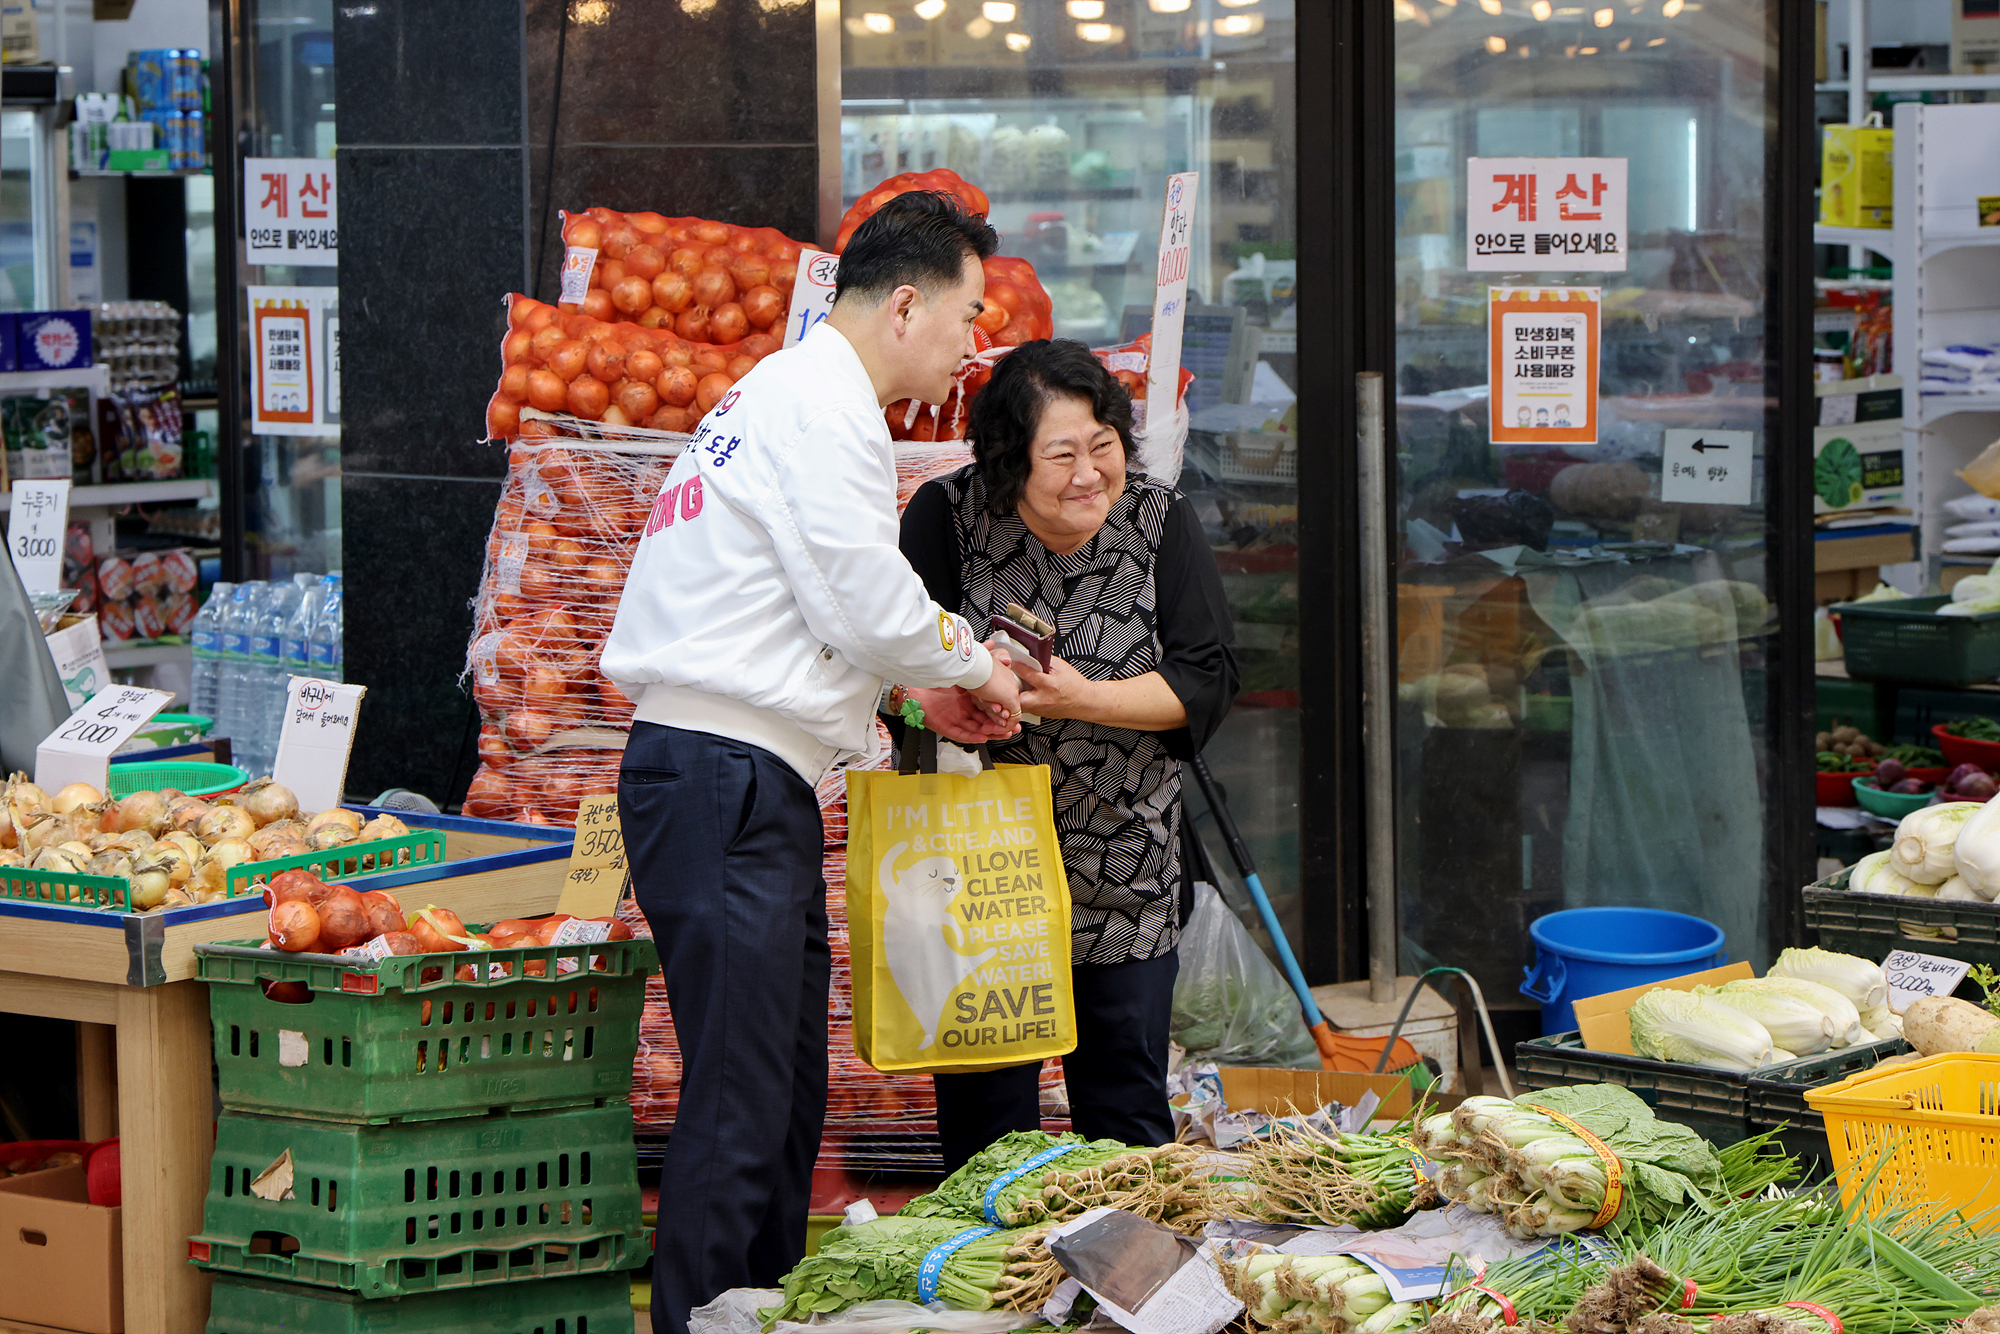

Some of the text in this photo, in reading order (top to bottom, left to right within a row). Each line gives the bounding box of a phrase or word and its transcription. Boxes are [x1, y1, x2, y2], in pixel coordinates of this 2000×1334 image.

[250, 229, 282, 249] 안으로
[1170, 209, 1188, 246] 양파
[1475, 231, 1620, 255] 안으로 들어오세요
[1514, 326, 1575, 342] 민생회복
[1514, 345, 1575, 360] 소비쿠폰
[1514, 363, 1576, 378] 사용매장
[21, 491, 58, 518] 누룽지
[117, 690, 148, 704] 양파
[912, 834, 928, 853] &
[987, 826, 1037, 849] AND
[962, 848, 1040, 875] I LOVE
[966, 873, 1043, 897] CLEAN
[960, 895, 1052, 922] WATER.
[968, 919, 1049, 945] PLEASE
[999, 940, 1049, 962] SAVE
[972, 962, 1053, 987] WATER!
[955, 982, 1056, 1024] SAVE
[942, 1018, 1057, 1049] OUR LIFE!
